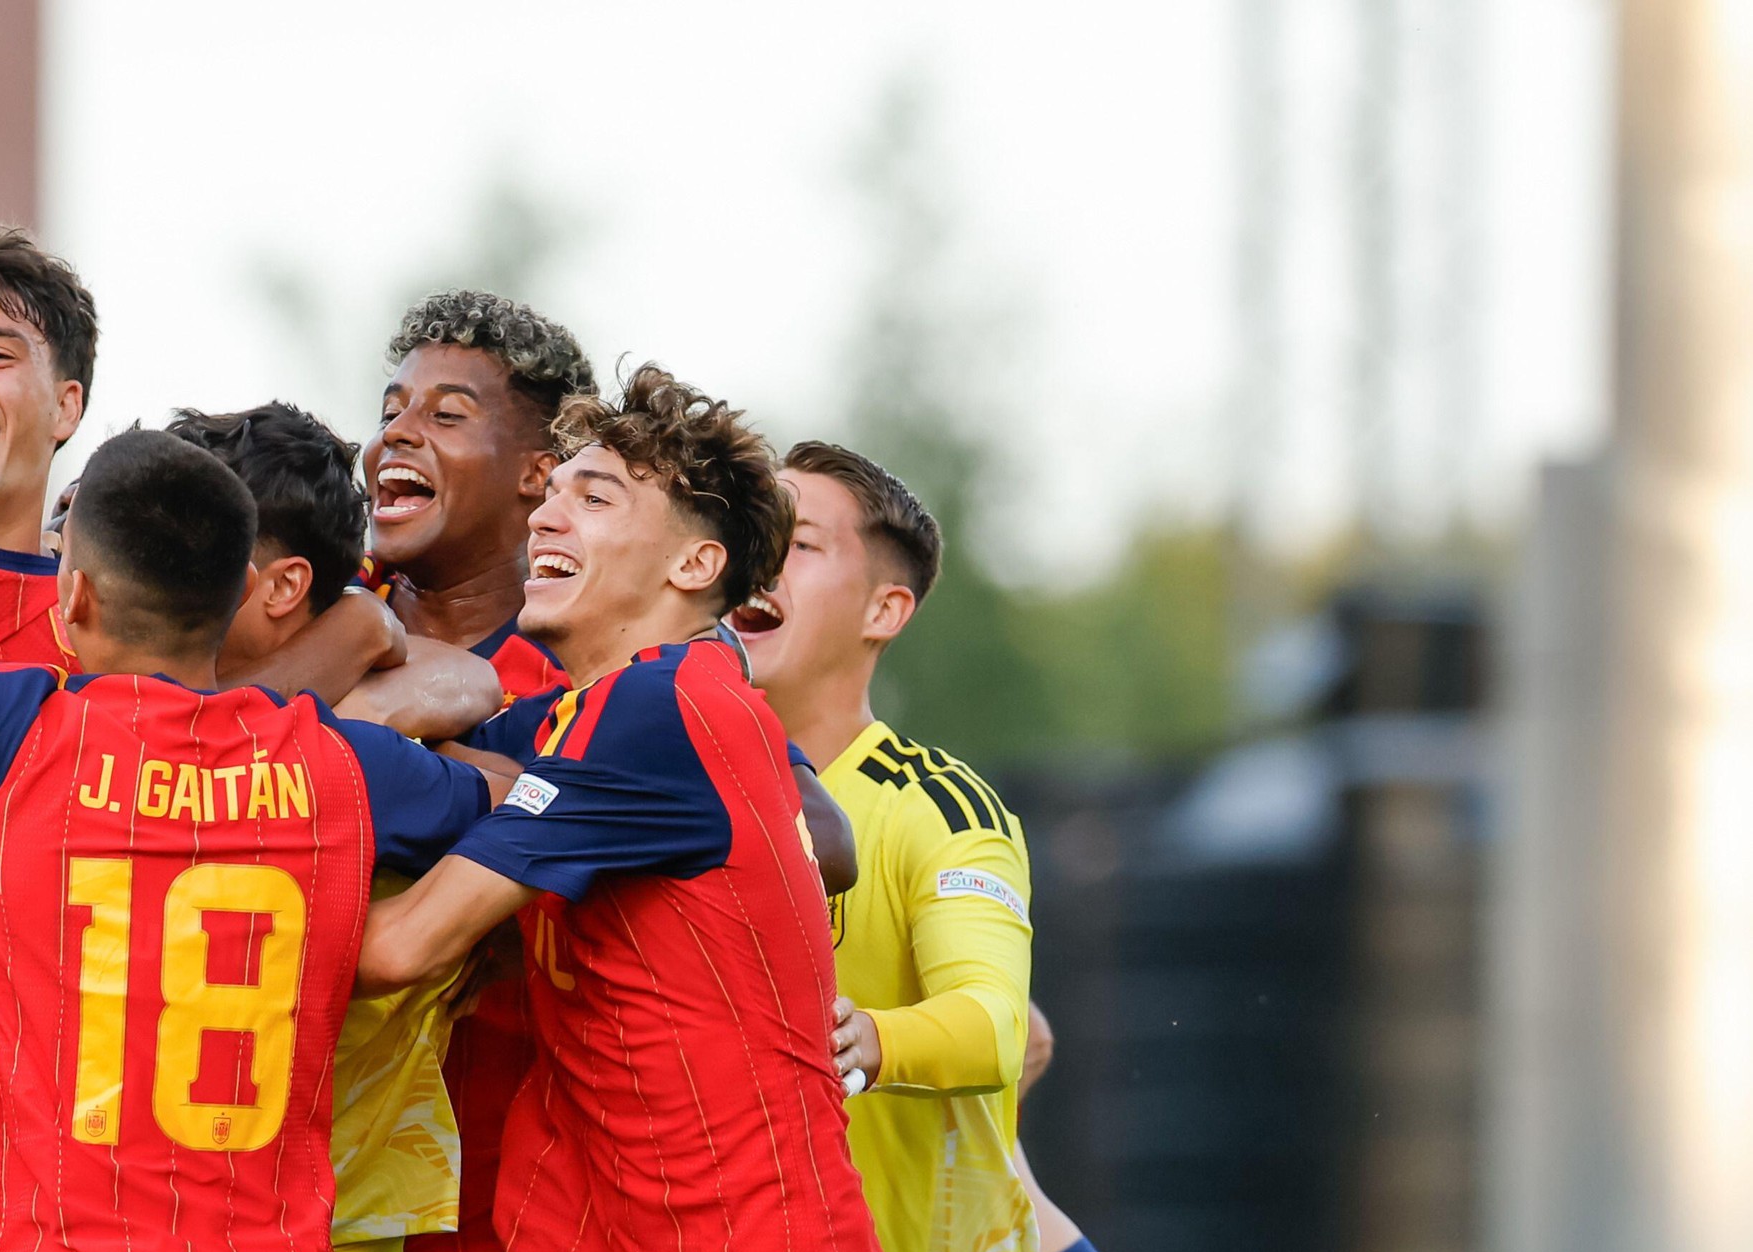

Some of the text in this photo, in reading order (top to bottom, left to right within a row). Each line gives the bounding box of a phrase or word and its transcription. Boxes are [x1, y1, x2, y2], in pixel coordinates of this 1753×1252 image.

[79, 749, 311, 823] J. GAITÁN
[940, 878, 1024, 915] FOUNDATION
[67, 857, 307, 1152] 18
